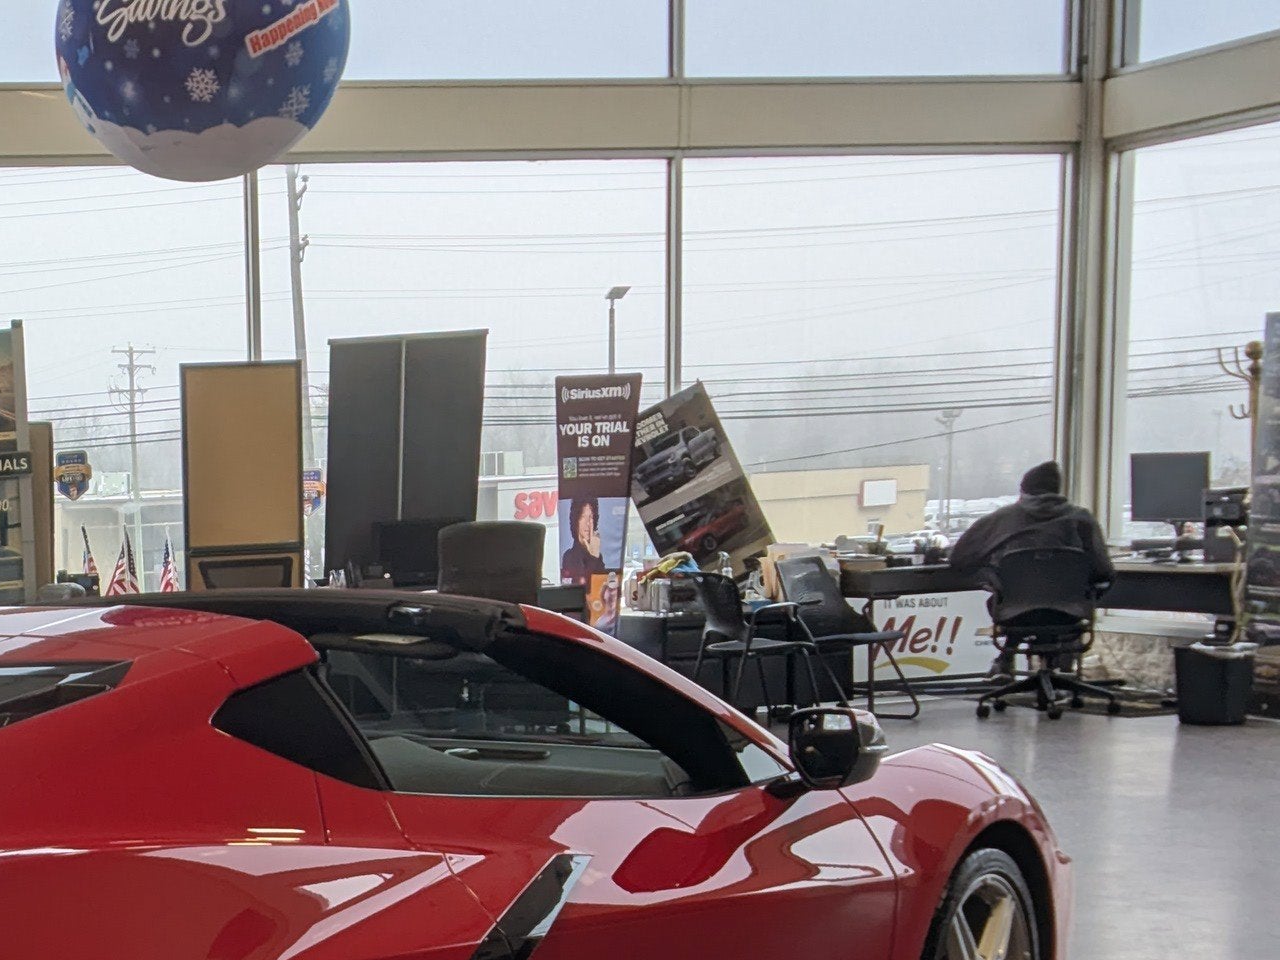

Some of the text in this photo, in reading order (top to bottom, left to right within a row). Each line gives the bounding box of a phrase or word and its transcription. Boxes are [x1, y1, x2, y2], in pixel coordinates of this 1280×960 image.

[249, 3, 319, 54] Happening
[559, 420, 630, 435] YOUR TRIAL
[577, 434, 610, 448] IS ON
[883, 597, 949, 609] IT WAS ABOUT
[873, 614, 963, 662] Me!!
